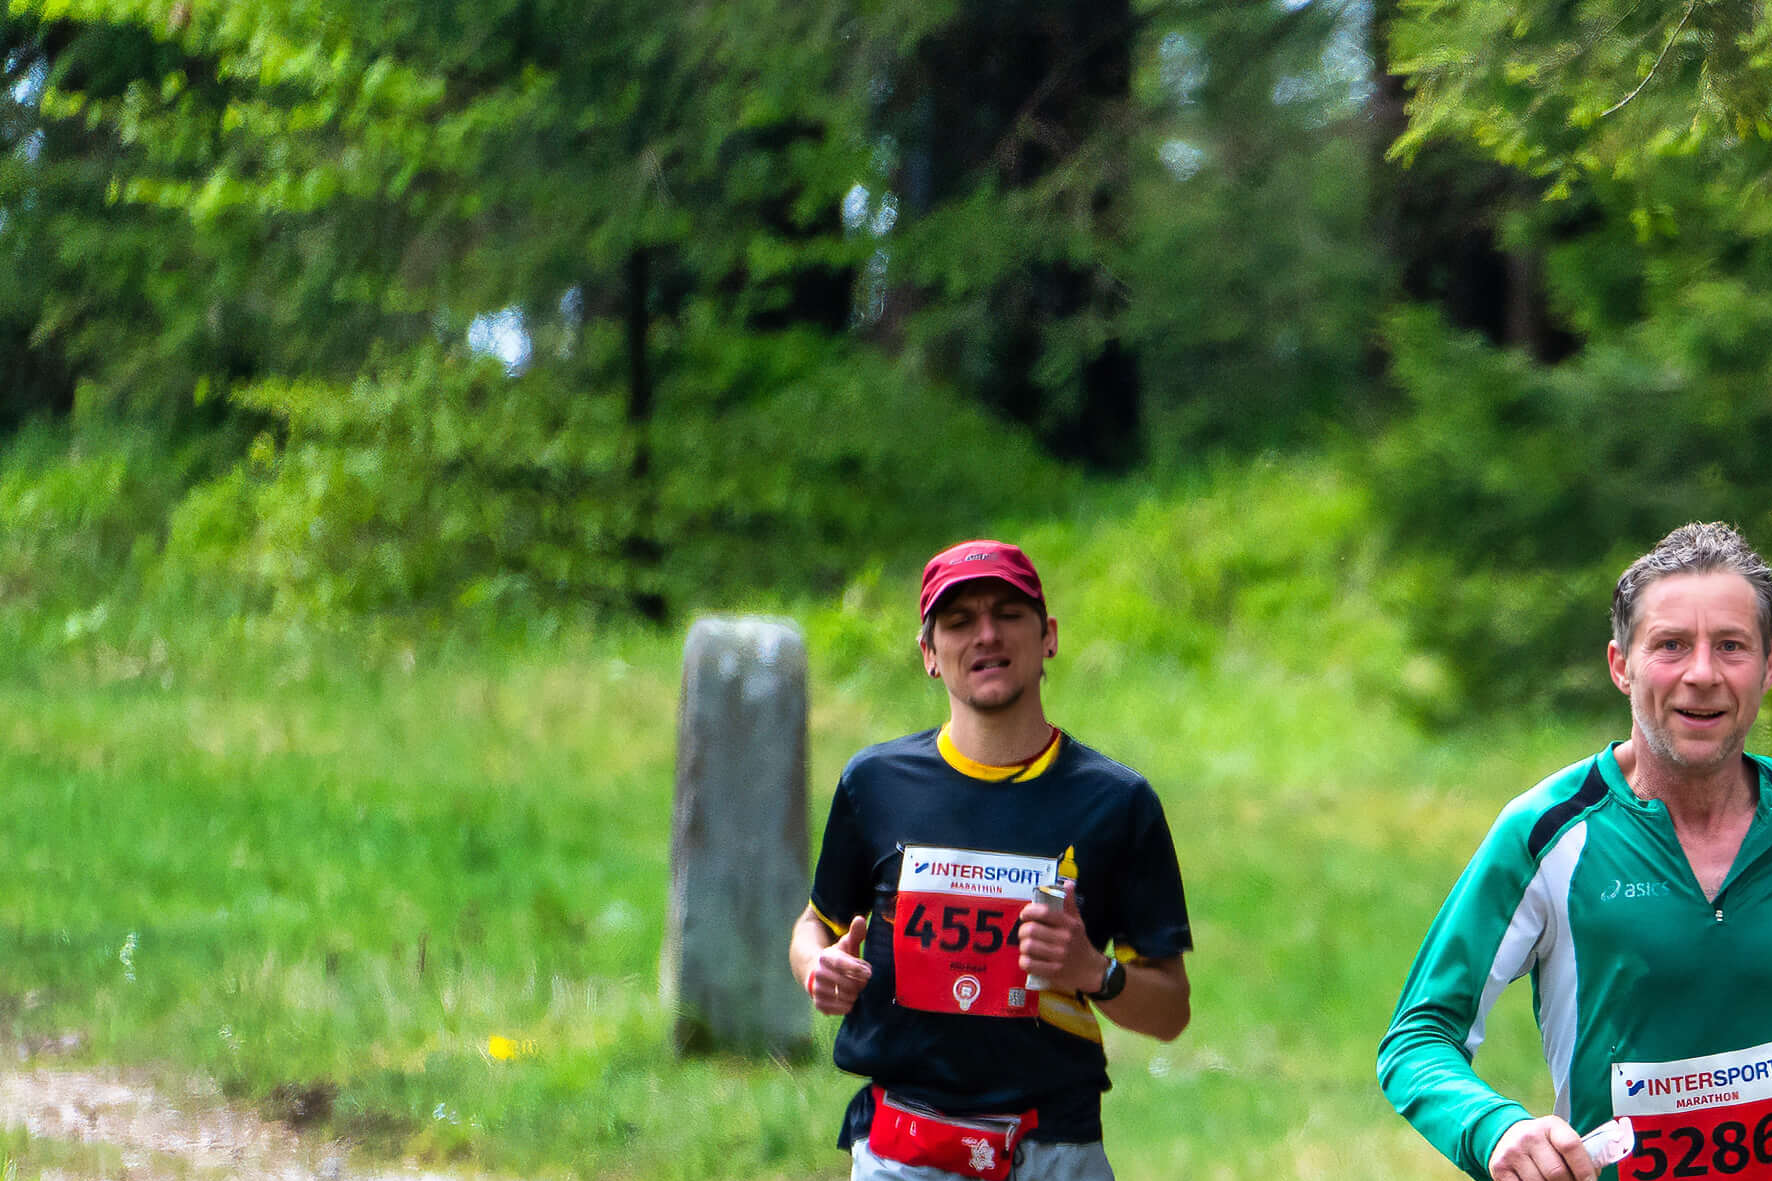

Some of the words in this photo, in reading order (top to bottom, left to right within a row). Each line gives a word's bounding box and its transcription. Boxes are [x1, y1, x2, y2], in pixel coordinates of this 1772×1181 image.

[931, 862, 1043, 885] INTERSPORT
[1625, 881, 1670, 897] asics
[1676, 1091, 1740, 1108] MARATHON
